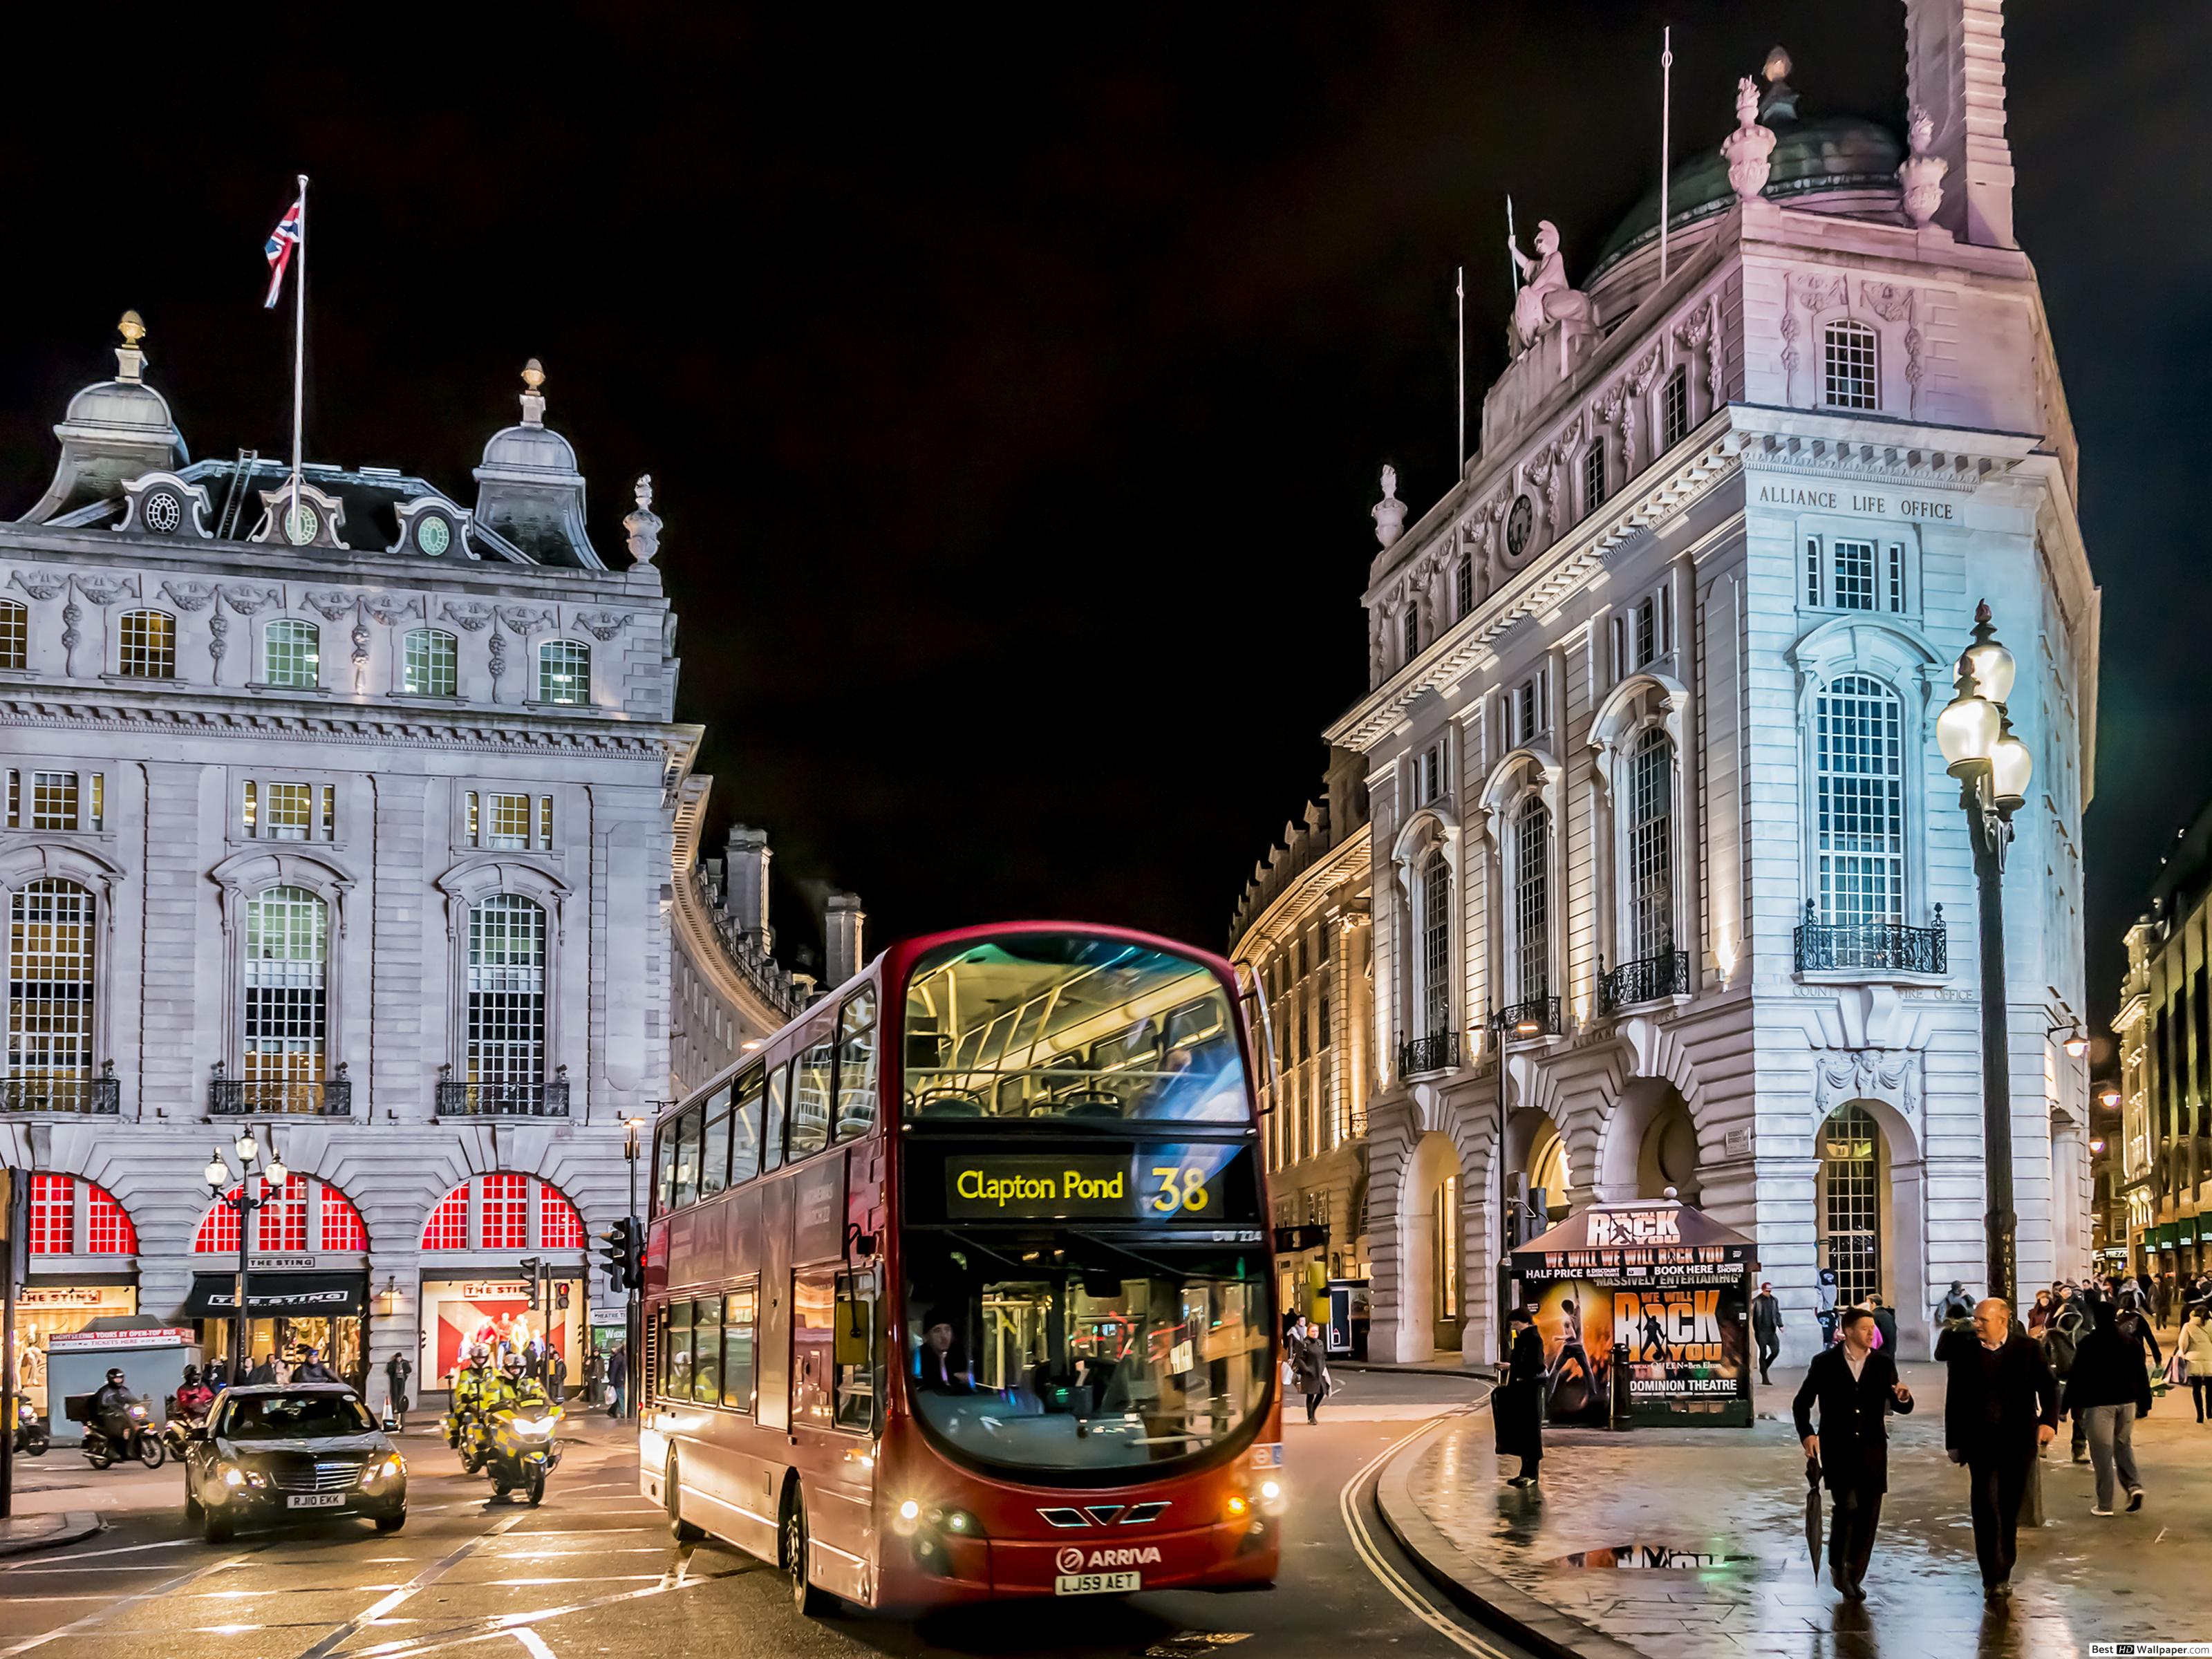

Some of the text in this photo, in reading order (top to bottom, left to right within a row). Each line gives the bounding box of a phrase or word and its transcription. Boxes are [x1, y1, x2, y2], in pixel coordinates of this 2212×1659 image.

[1760, 487, 1953, 519] ALLIANCE LIFE OFFICE
[1792, 985, 1974, 1000] COUNTY FIRE OFFICE
[957, 1167, 1209, 1212] Clapton Pond 38
[1587, 1210, 1680, 1246] ROCK
[1633, 1235, 1680, 1245] YOU
[1545, 1252, 1564, 1268] WE
[1568, 1251, 1597, 1267] WILL
[1601, 1250, 1620, 1266] WE
[1624, 1249, 1654, 1265] WILL
[1658, 1248, 1694, 1264] ROCK
[1698, 1246, 1724, 1263] YOU
[1526, 1268, 1583, 1279] HALF PRICE
[1655, 1266, 1685, 1275] BOOK
[1687, 1264, 1714, 1274] HERE
[267, 1293, 341, 1304] STING
[1641, 1291, 1693, 1302] WE WILL
[129, 1329, 161, 1338] OPEN-TOP
[1614, 1290, 1722, 1362] ROCK
[1667, 1343, 1722, 1361] YOU
[1630, 1379, 1736, 1391] DOMINION THEATRE
[294, 1494, 339, 1506] RJ10 EKK
[1087, 1546, 1162, 1567] ARRIVA
[1062, 1573, 1134, 1592] LJ59 AET
